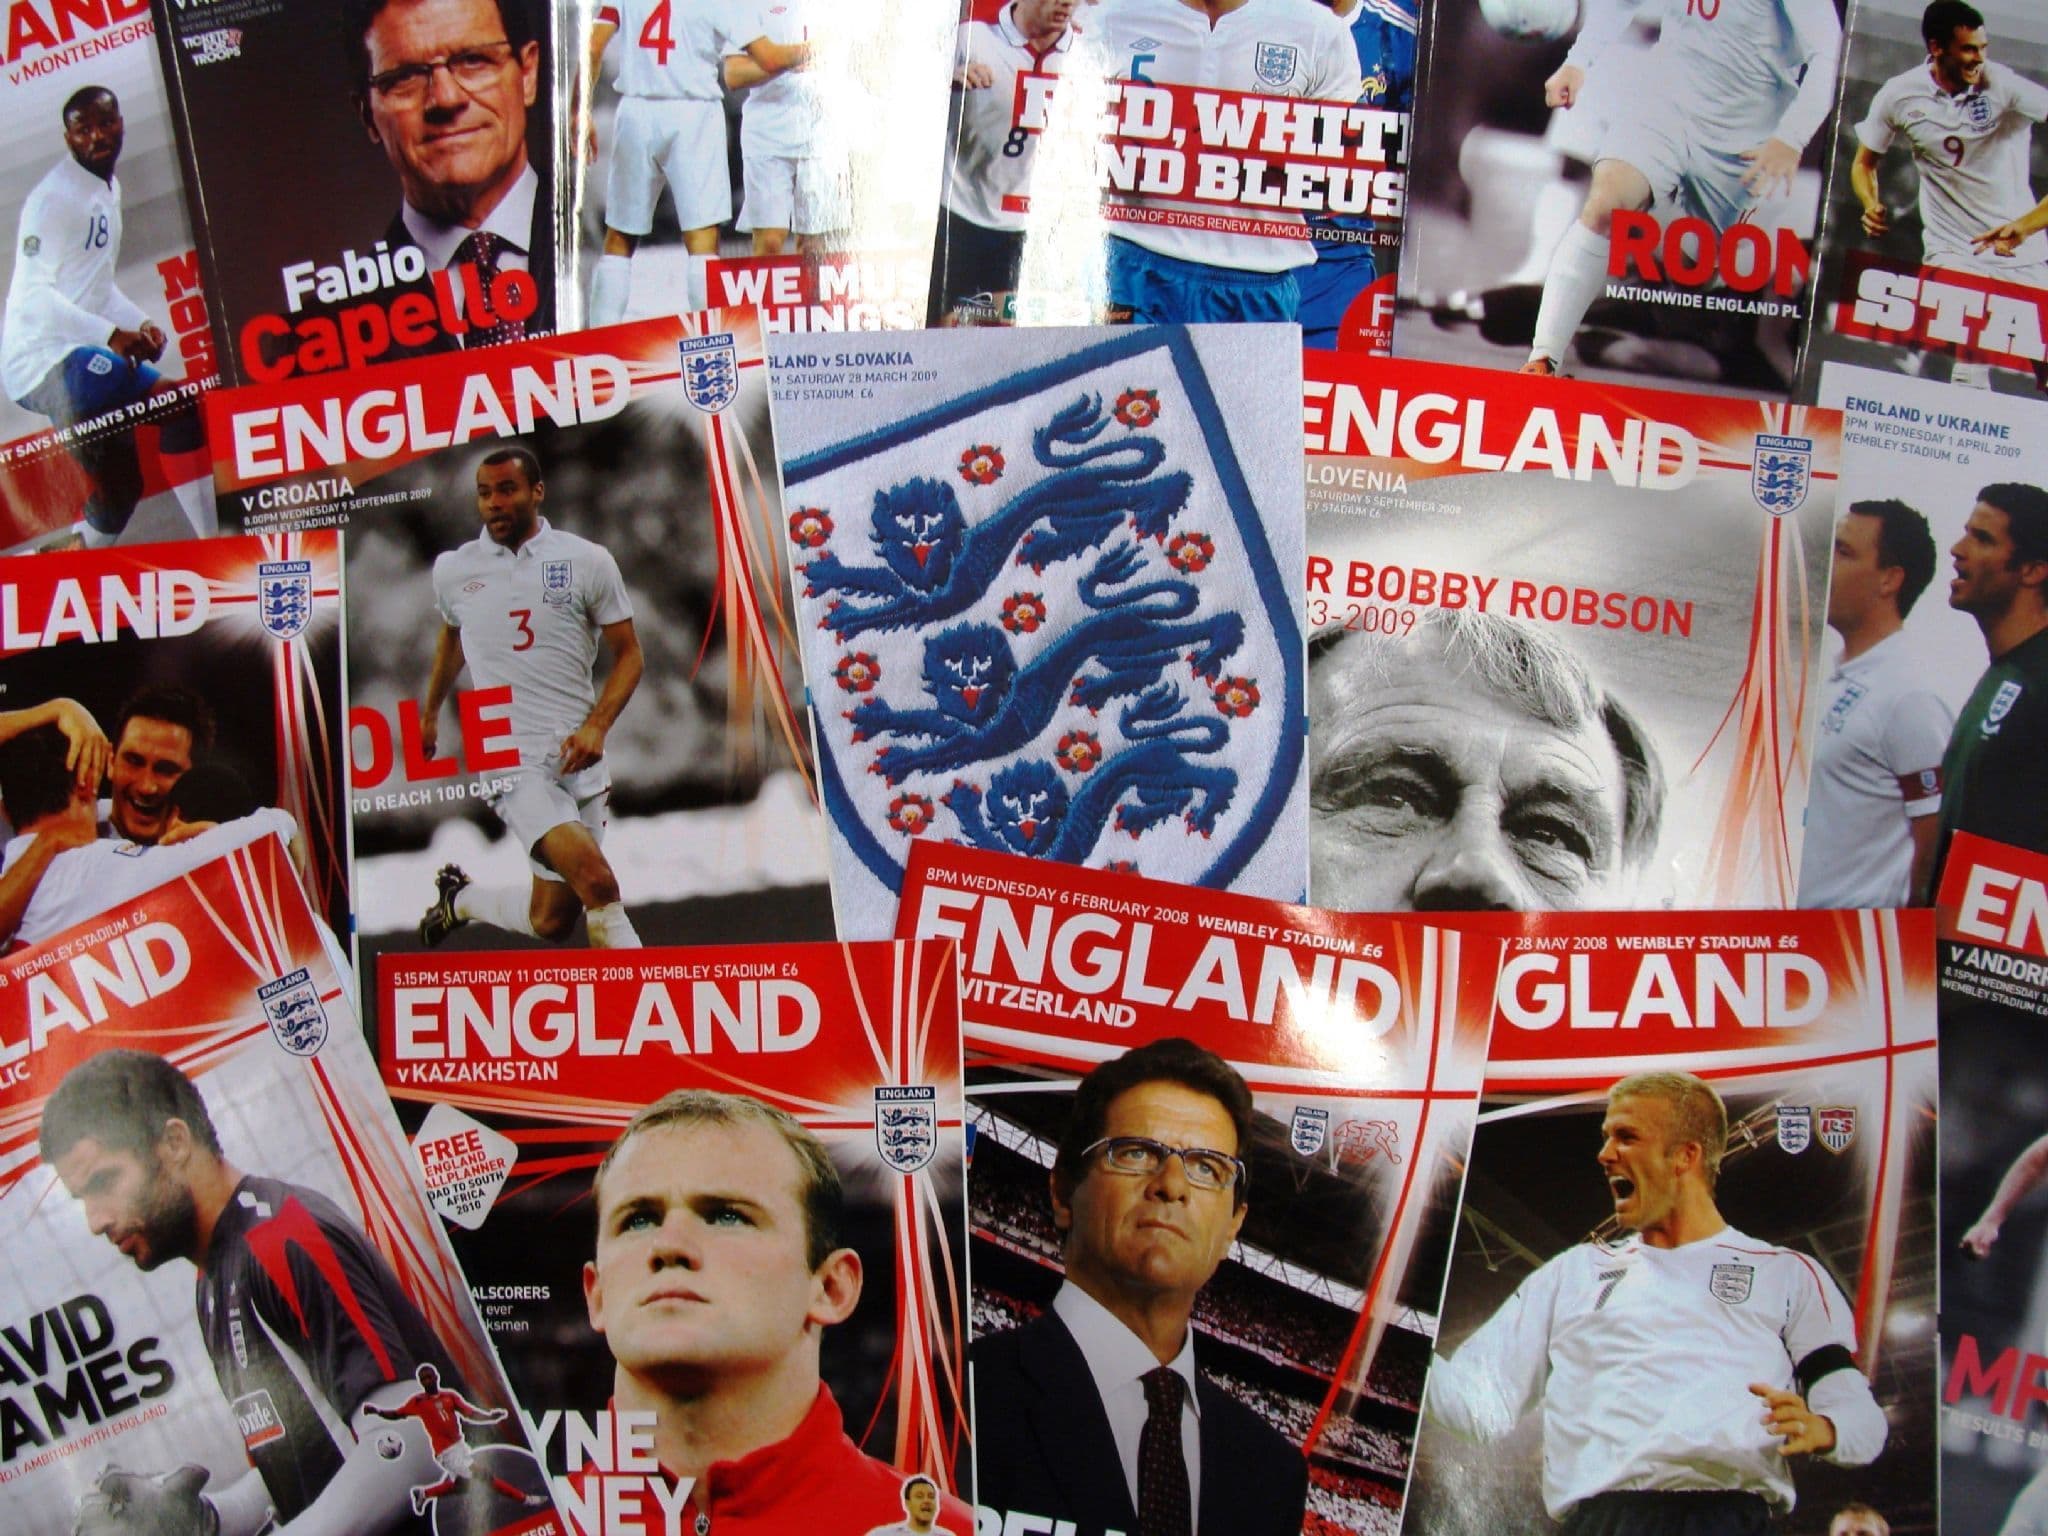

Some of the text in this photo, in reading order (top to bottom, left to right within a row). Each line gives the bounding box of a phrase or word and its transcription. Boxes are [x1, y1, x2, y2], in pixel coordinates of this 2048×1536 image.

[182, 28, 228, 49] TICKETS
[639, 0, 676, 65] 4
[192, 46, 241, 66] TROOPS
[10, 72, 20, 86] v
[1003, 127, 1028, 158] 8
[1943, 136, 1965, 168] 9
[1194, 153, 1404, 218] BLEUS
[85, 214, 109, 250] 18
[1149, 208, 1165, 223] OF
[1167, 212, 1205, 229] STARS
[1207, 217, 1250, 233] RENEW
[1252, 222, 1262, 234] A
[1264, 223, 1313, 240] FAMOUS
[1315, 229, 1376, 245] FOOTBALL
[282, 242, 426, 313] Fabio
[720, 266, 801, 307] WE
[953, 305, 999, 317] WEMBLEY
[1606, 284, 1702, 309] NATIONWIDE
[1706, 296, 1778, 317] ENGLAND
[1853, 268, 2048, 361] STA
[240, 262, 538, 384] Capello
[681, 335, 730, 353] ENGLAND
[822, 357, 831, 368] v
[835, 351, 914, 366] SLOVAKIA
[787, 370, 938, 386] SATURDAY 28 MARCH 2009
[803, 388, 854, 401] STADIUM
[16, 382, 199, 459] SAYS HE WANTS TO ADD TO
[232, 353, 632, 481] ENGLAND
[1845, 396, 2011, 439] ENGLAND v UKRAINE
[1759, 436, 1809, 450] ENGLAND
[1844, 432, 1899, 451] WEMBLEY
[1901, 443, 1951, 460] STADIUM
[1874, 423, 1946, 445] WEDNESDAY
[1957, 439, 1991, 454] APRIL
[1994, 445, 2021, 459] 2009
[258, 476, 355, 509] CROATIA
[1306, 464, 1408, 494] LOVENIA
[243, 487, 433, 526] 8.00PM WEDNESDAY 9 SEPTEMBER 2009
[1310, 488, 1362, 503] SATURDAY
[1373, 496, 1436, 513] SEPTEMBER
[1322, 503, 1367, 516] STADIUM
[244, 522, 293, 537] WEMBLEY
[294, 515, 337, 531] STADIUM
[262, 562, 308, 575] ENGLAND
[1, 569, 211, 651] LAND
[1347, 561, 1498, 613] BOBBY
[1508, 580, 1694, 638] ROBSON
[508, 609, 537, 652] 3
[1306, 599, 1417, 637] 3-2009
[348, 685, 521, 790] OLE
[352, 798, 371, 814] TO
[375, 789, 432, 812] REACH
[436, 783, 466, 802] 100
[926, 867, 1383, 958] 8PM WEDNESDAY 6 FEBRUARY 2008 WEMBLEY STADIUM £6
[12, 943, 74, 981] WEMBLEY
[75, 917, 129, 951] STADIUM
[1515, 937, 1532, 950] 28
[1536, 937, 1569, 950] MAY
[1573, 937, 1607, 950] 2008
[1616, 936, 1695, 950] WEMBLEY
[1700, 936, 1771, 950] STADIUM
[1778, 936, 1799, 949] £6
[394, 962, 799, 985] 5.15PM SATURDAY 11 OCTOBER 2008 WEMBLEY STADIUM £6
[914, 885, 1400, 1038] ENGLAND
[1964, 947, 2048, 986] ANDOR
[262, 971, 306, 997] ENGLAND
[1499, 953, 1829, 1030] GLAND
[1942, 977, 1990, 999] WEMBLEY
[1991, 992, 2035, 1011] STADIUM
[1945, 966, 2040, 1000] 8.15PM WEDNESDAY
[394, 979, 821, 1060] ENGLAND
[396, 1060, 558, 1084] v KAZAKHSTAN
[878, 1088, 932, 1100] ENGLAND
[418, 1129, 483, 1165] FREE
[425, 1150, 486, 1177] ENGLAND
[447, 1188, 487, 1207] AFRICA
[454, 1171, 504, 1192] TO SOUTH
[456, 1200, 482, 1216] 2010
[471, 1286, 551, 1300] ALSCORERS
[1594, 1268, 1628, 1311] 7
[486, 1303, 513, 1315] ever
[486, 1318, 529, 1332] ksmen
[1, 1336, 175, 1462] AMES
[23, 1403, 168, 1473] AMBITION WITH ENGLAND
[521, 1409, 659, 1473] YNE
[552, 1475, 697, 1536] NEY
